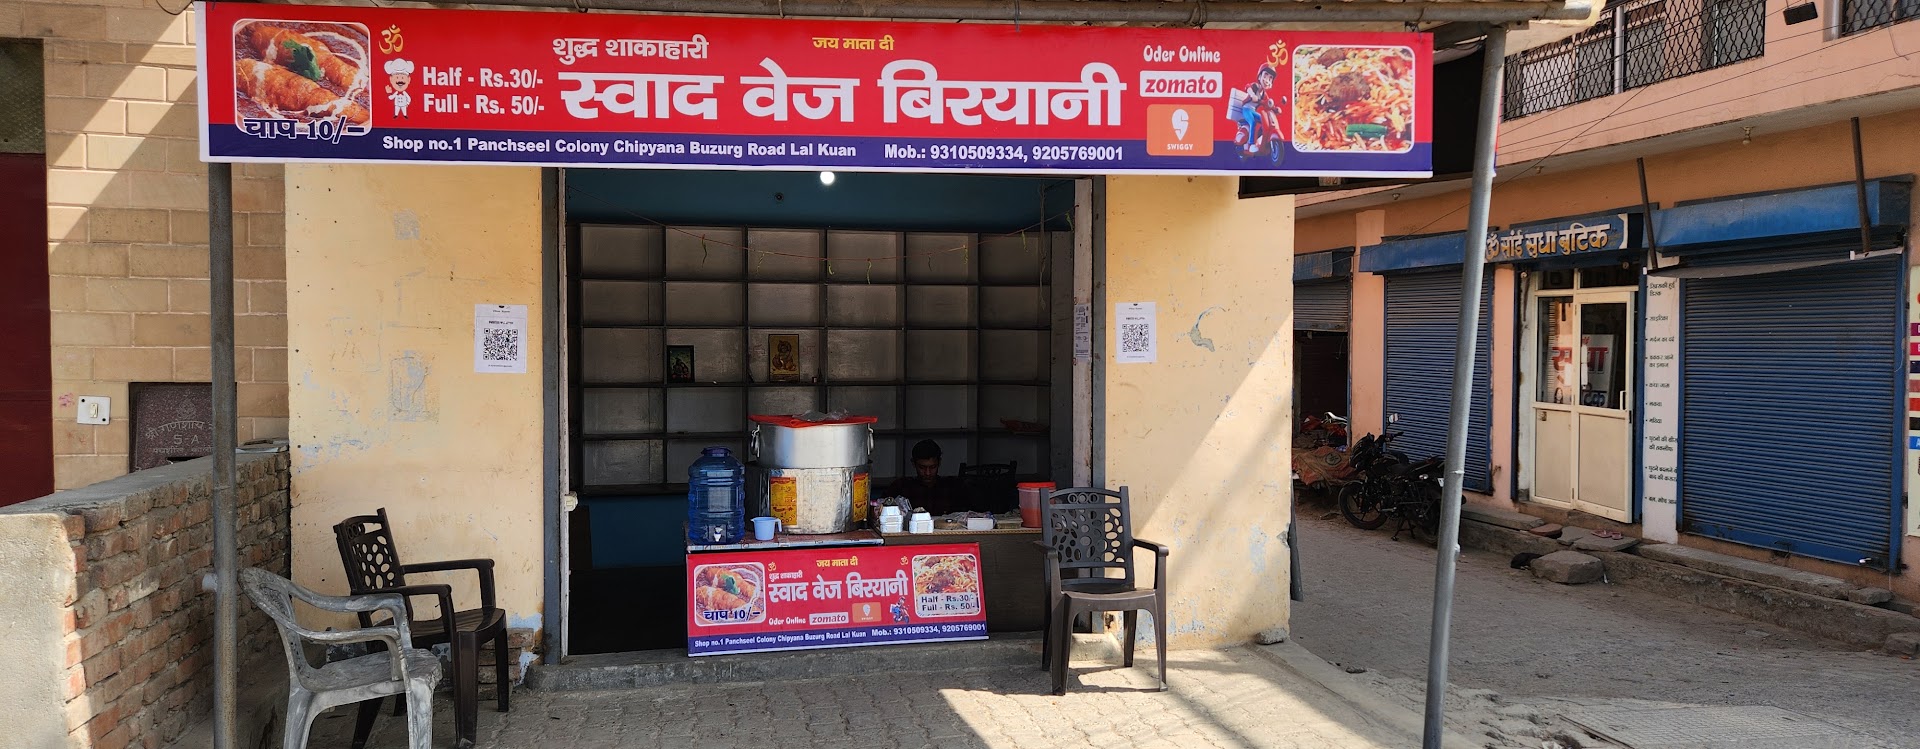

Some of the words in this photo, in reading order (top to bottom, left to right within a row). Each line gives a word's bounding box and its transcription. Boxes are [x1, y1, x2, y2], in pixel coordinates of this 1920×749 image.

[552, 37, 600, 65] शुद्ध
[605, 33, 709, 60] शाकाहारी
[812, 36, 839, 50] जय
[842, 37, 875, 50] माता
[879, 35, 894, 51] दी
[1143, 44, 1175, 62] Oder
[1179, 45, 1221, 63] Online
[423, 66, 462, 87] Half
[480, 68, 544, 89] Rs.30/-
[1145, 75, 1217, 94] zomato
[558, 72, 724, 120] स्वाद
[739, 56, 860, 123] वेज
[877, 59, 1127, 126] बिरयानी
[423, 93, 458, 113] Full
[476, 95, 505, 114] Rs.
[511, 95, 545, 115] 50/-
[243, 117, 299, 139] चाप
[307, 116, 365, 145] 10/-
[383, 135, 423, 152] Shop
[428, 137, 461, 151] no.1
[468, 137, 550, 153] Panchseel
[555, 139, 609, 156] Colony
[614, 139, 685, 156] Chipyana
[690, 141, 743, 158] Buzurg
[748, 142, 786, 156] Road
[790, 143, 813, 156] Lal
[818, 143, 857, 157] Kuan
[884, 144, 926, 159] Mob.:
[930, 145, 1028, 163] 9310509334,
[1032, 146, 1123, 161] 9205769001
[1167, 143, 1193, 151] SWIGGY
[1559, 223, 1611, 255] बुटिक
[816, 559, 830, 568] जय
[832, 558, 848, 567] माता
[850, 555, 858, 566] दी
[768, 582, 809, 603] स्वाद
[812, 574, 842, 600] वेज
[846, 569, 908, 598] बिरयानी
[703, 610, 728, 621] चाप
[734, 606, 761, 622] 10/-
[786, 617, 806, 625] Online
[812, 614, 846, 624] zomato
[872, 629, 892, 637] Mob.:
[942, 623, 985, 633] 9205769001
[694, 640, 709, 648] Shop
[711, 638, 723, 647] no.1
[725, 637, 755, 645] Panchseel
[756, 635, 776, 644] Colony
[777, 634, 804, 643] Chipyana
[805, 633, 825, 641] Buzurg
